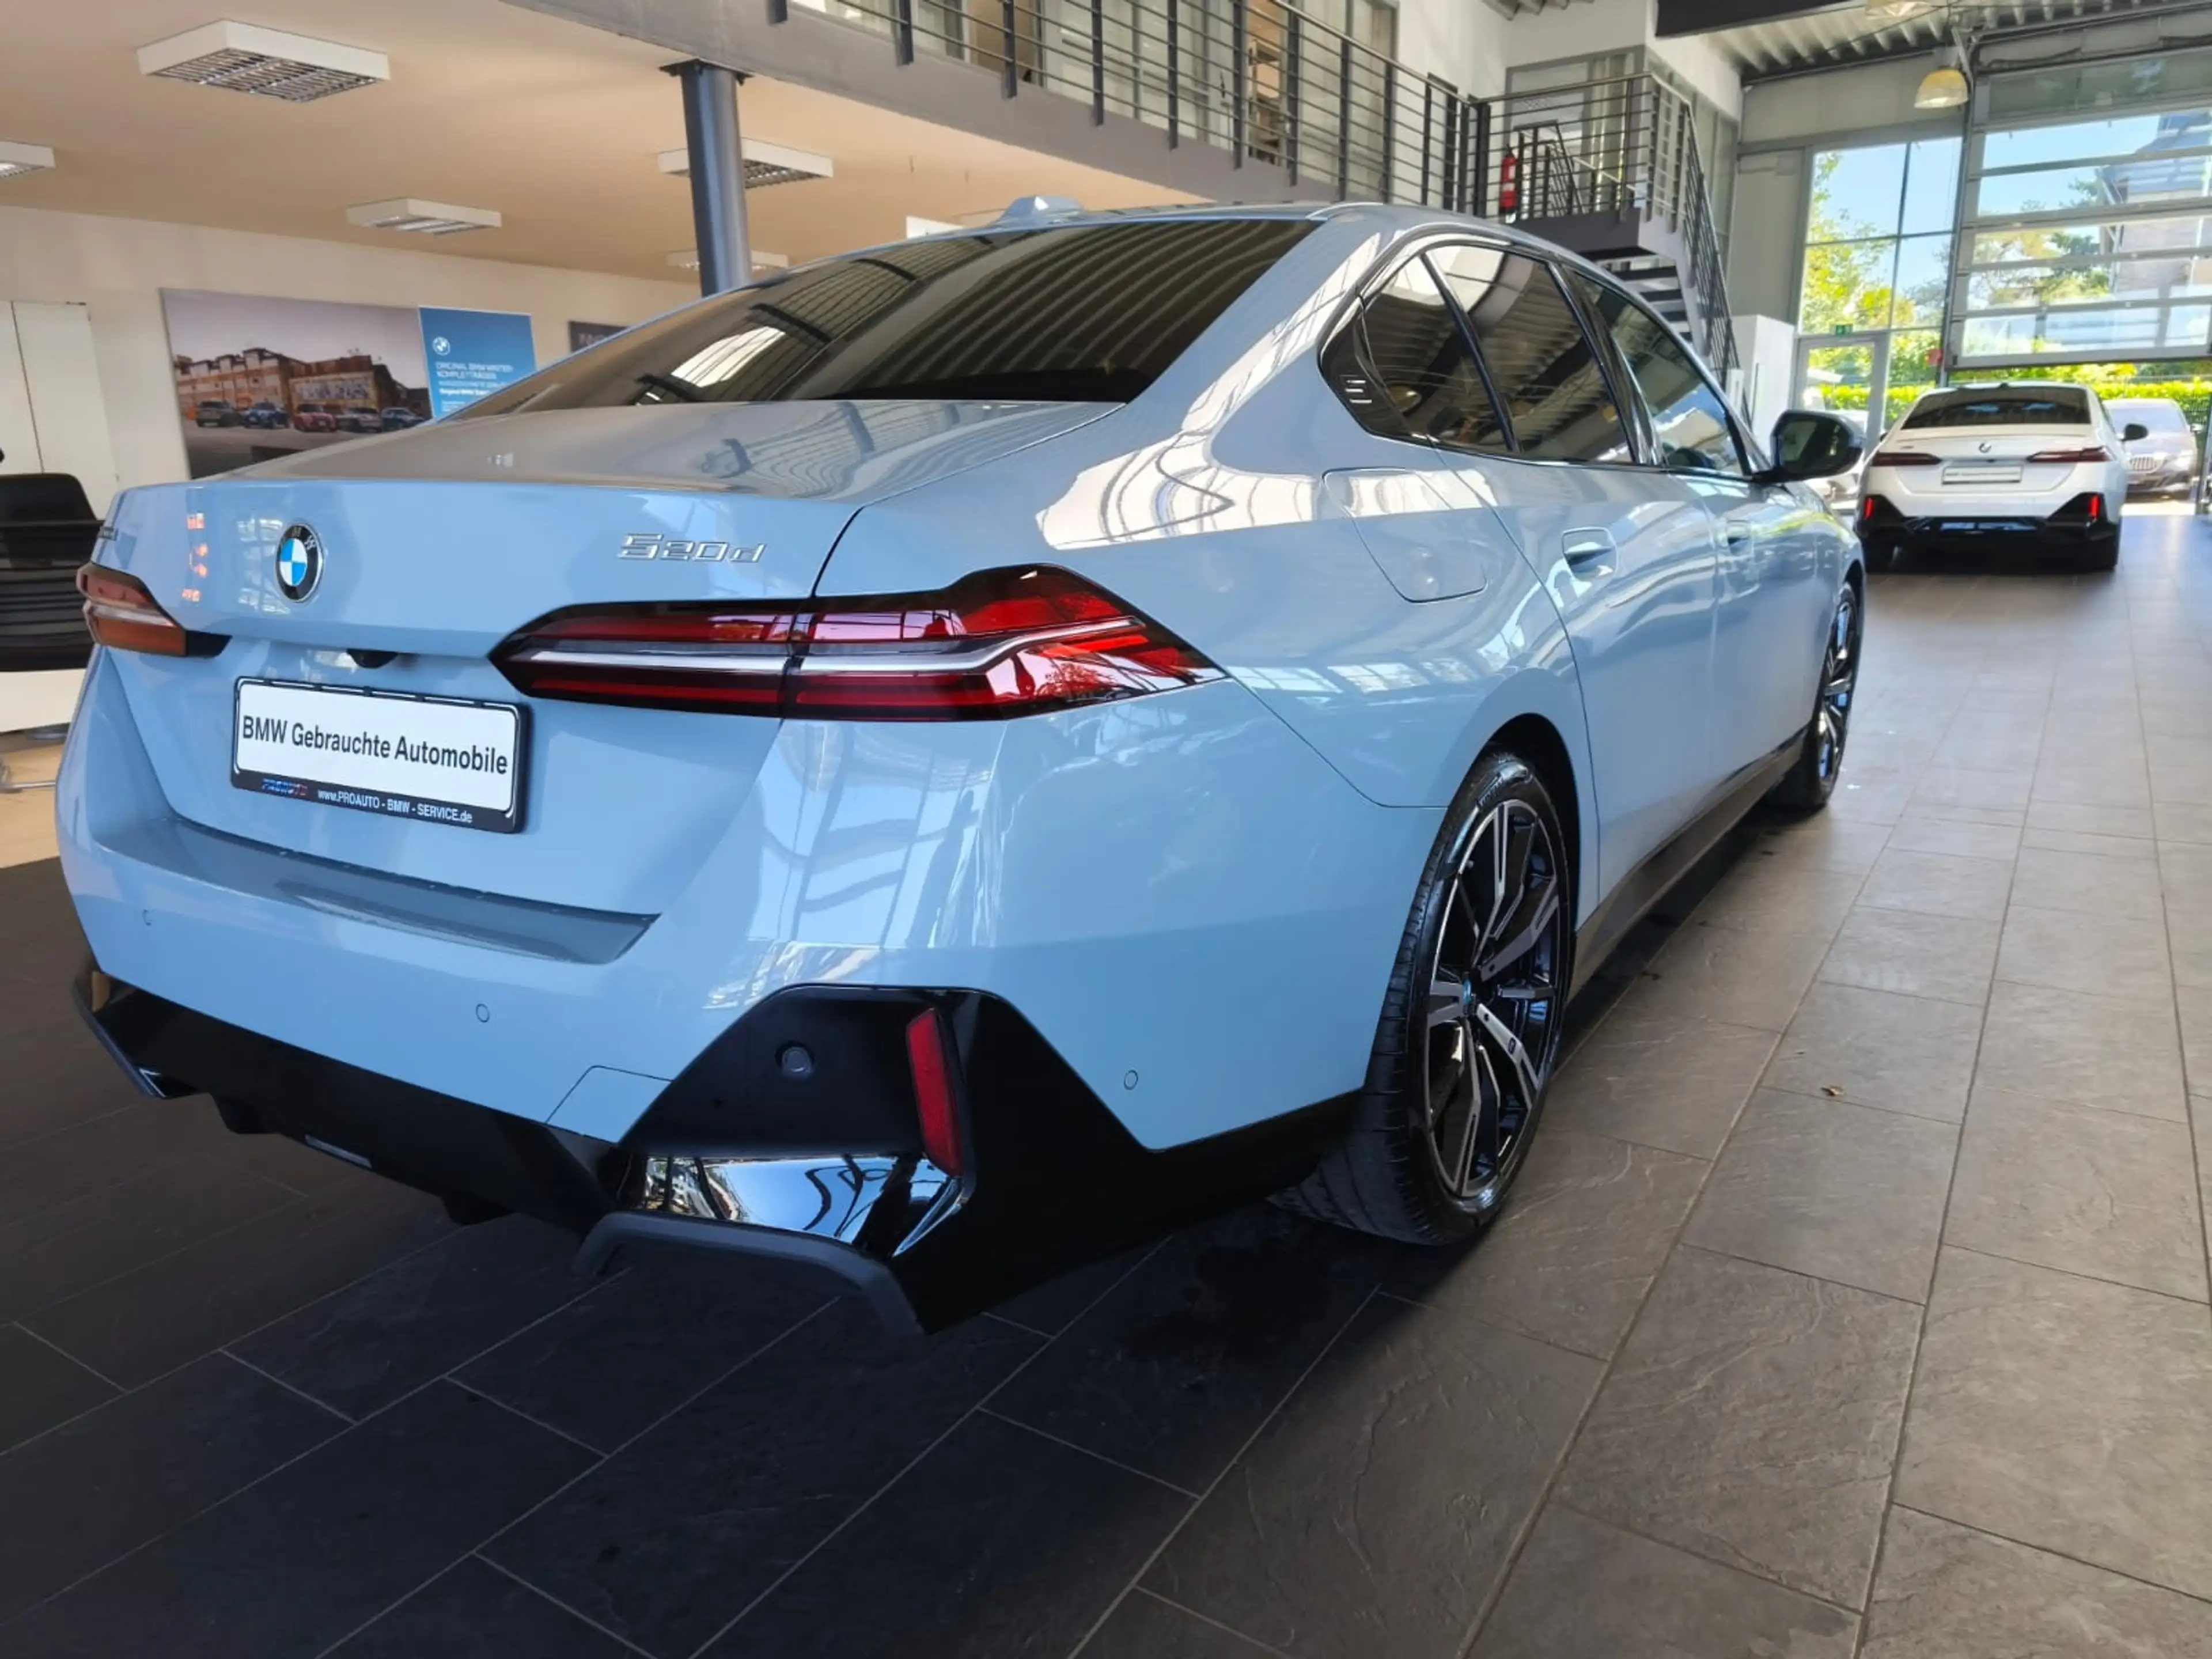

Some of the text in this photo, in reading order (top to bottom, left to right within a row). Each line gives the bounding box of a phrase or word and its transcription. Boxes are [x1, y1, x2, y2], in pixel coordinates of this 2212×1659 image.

[617, 533, 767, 562] 520d
[242, 715, 508, 775] BMW Gebrauchte Automobile
[387, 800, 410, 813] BMW
[417, 804, 472, 823] SERVICE.de
